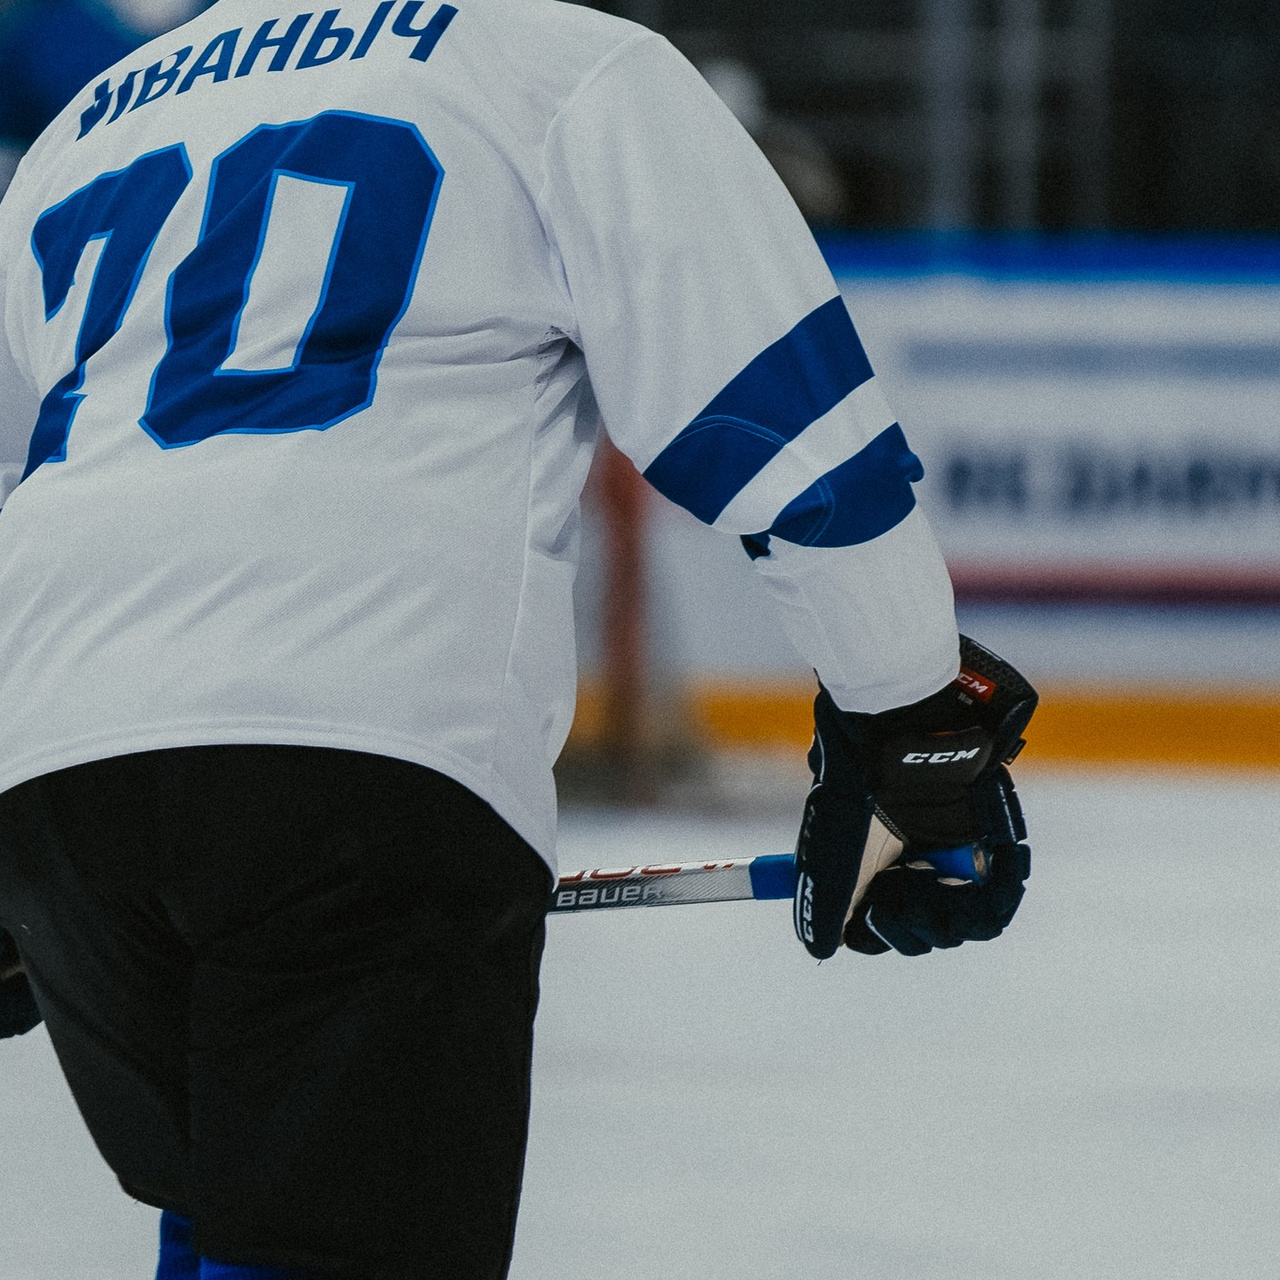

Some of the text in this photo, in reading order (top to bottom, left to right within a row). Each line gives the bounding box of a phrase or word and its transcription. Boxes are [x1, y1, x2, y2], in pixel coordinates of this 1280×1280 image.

[75, 0, 459, 142] ИВАНЫЧ
[20, 108, 446, 485] 70
[958, 672, 988, 693] CM
[902, 747, 980, 763] CCM
[803, 876, 815, 943] CCM
